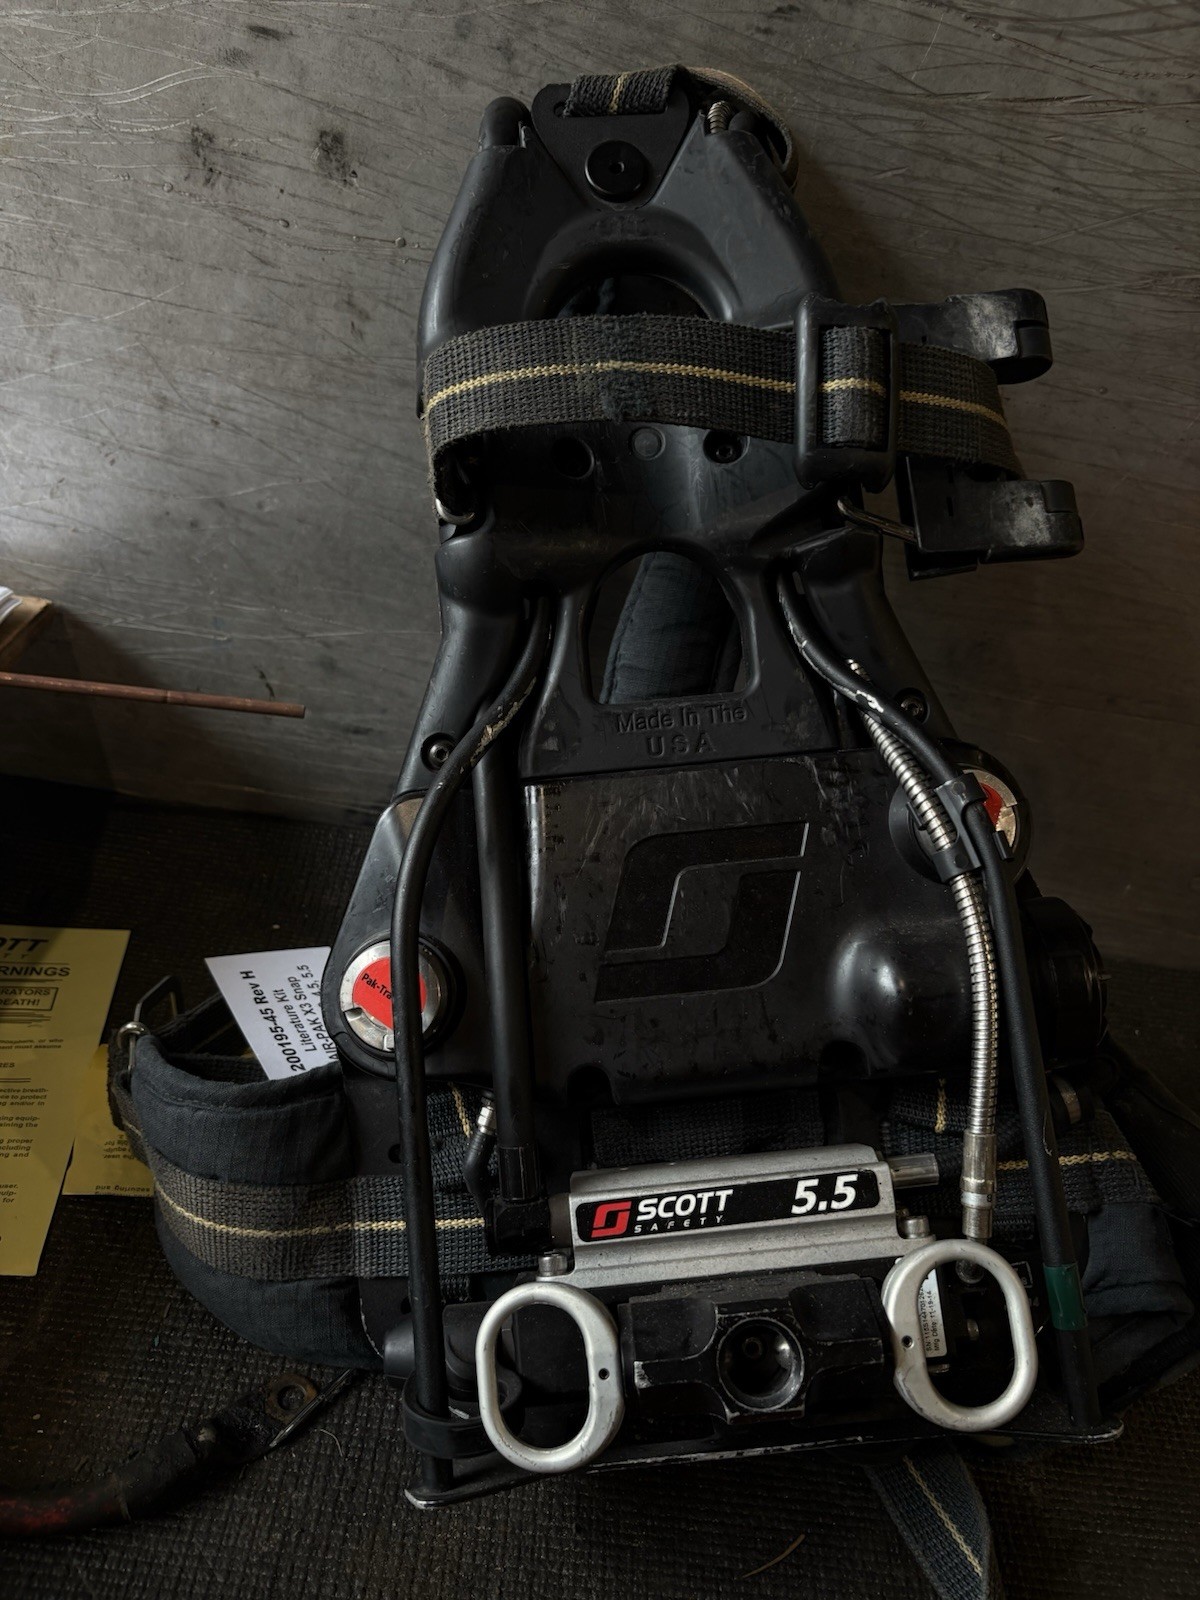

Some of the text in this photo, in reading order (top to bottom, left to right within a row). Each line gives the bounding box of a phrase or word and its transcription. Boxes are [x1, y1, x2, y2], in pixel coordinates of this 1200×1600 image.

[617, 702, 747, 733] Made In The
[297, 964, 315, 979] 5.5
[240, 970, 306, 1072] 200195-45 Rev H
[273, 988, 317, 1052] Literature Kit
[288, 976, 339, 1060] AIR-PAK X3 Snap
[636, 1174, 858, 1221] SCOTT 5.5
[634, 1214, 724, 1234] SAFETY
